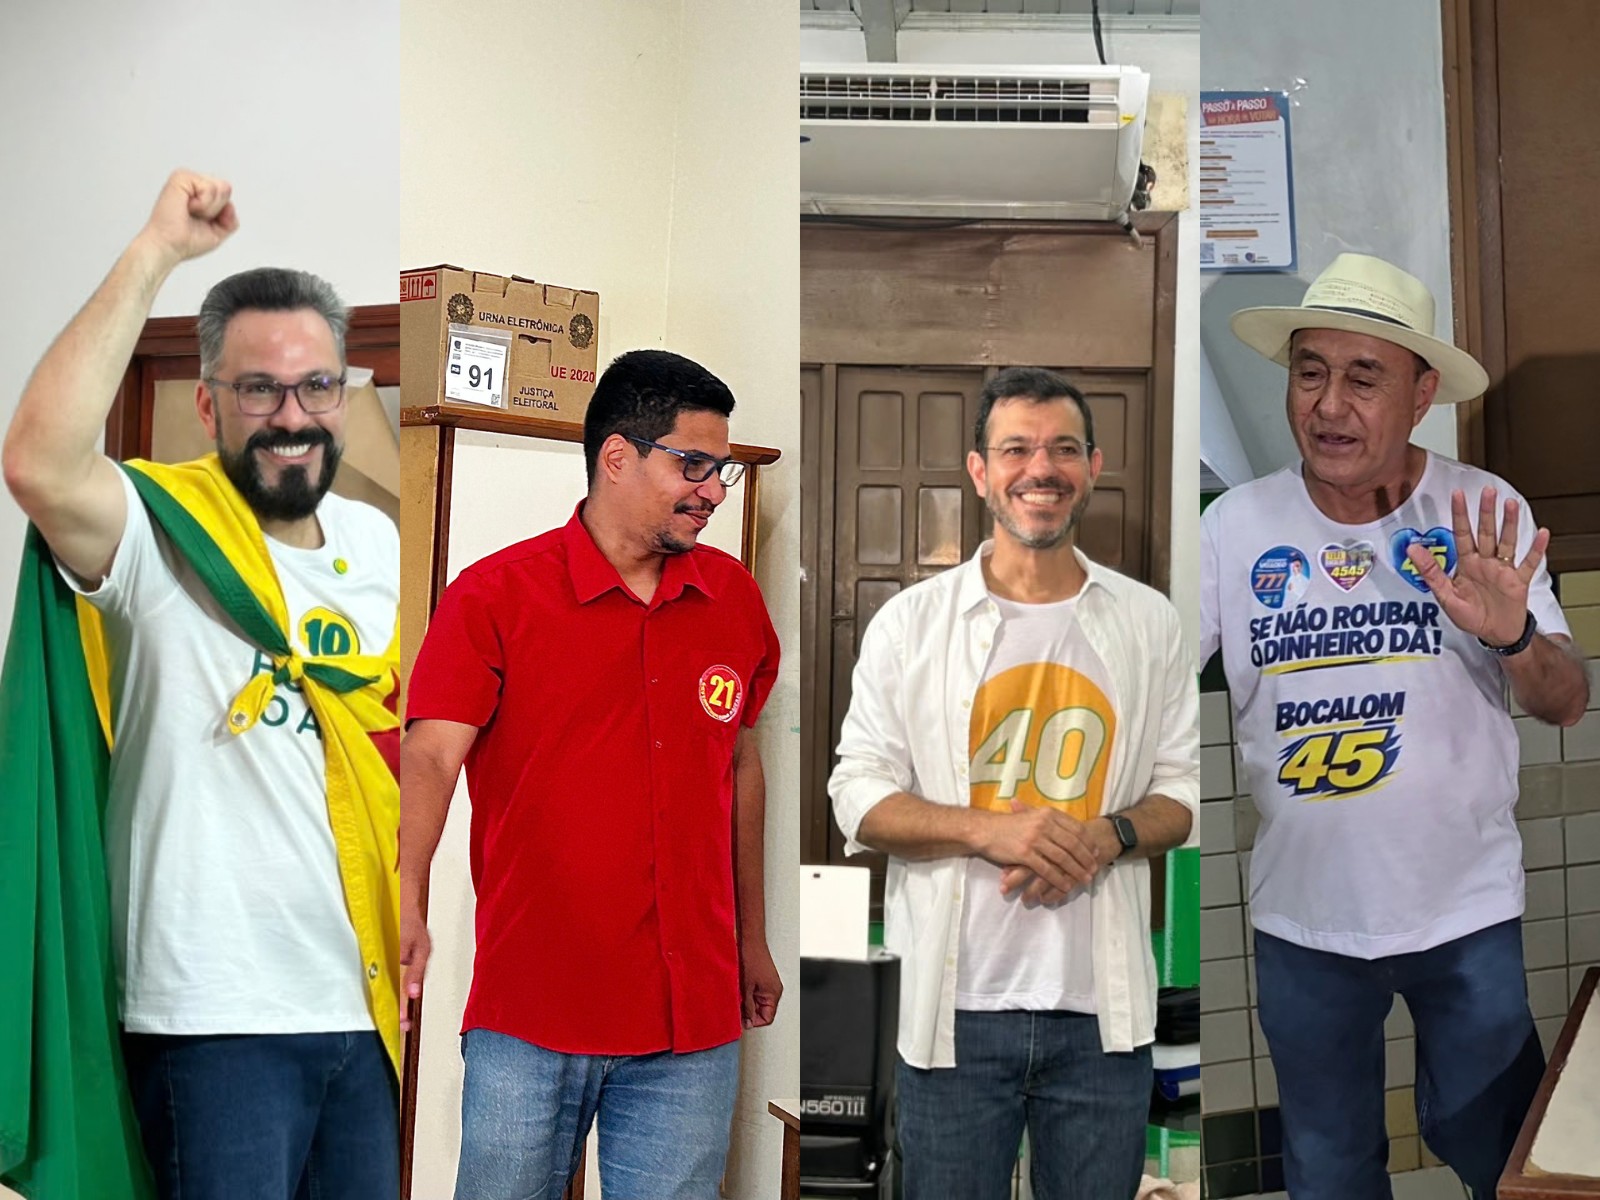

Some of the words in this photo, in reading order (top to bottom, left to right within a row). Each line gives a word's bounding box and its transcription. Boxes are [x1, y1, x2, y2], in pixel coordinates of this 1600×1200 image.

[1202, 102, 1230, 113] PASSO
[1236, 98, 1268, 111] PASSO
[479, 312, 506, 325] URNA
[507, 317, 565, 335] ELETRÔNICA
[469, 365, 493, 390] 91
[551, 365, 567, 379] UE
[570, 369, 595, 383] 2020
[513, 397, 560, 411] ELEITORAL
[519, 386, 555, 399] JUSTIÇA
[1255, 573, 1287, 589] 777
[1330, 565, 1365, 578] 4545
[1250, 616, 1273, 642] SE
[1274, 602, 1327, 636] NÃO
[1331, 602, 1439, 630] ROUBAR
[305, 618, 350, 657] 10
[1251, 645, 1263, 668] O
[1263, 629, 1385, 664] DINHEIRO
[708, 675, 735, 710] 21
[1275, 691, 1406, 732] BOCALOM
[969, 706, 1106, 802] 40
[1278, 727, 1392, 791] 45
